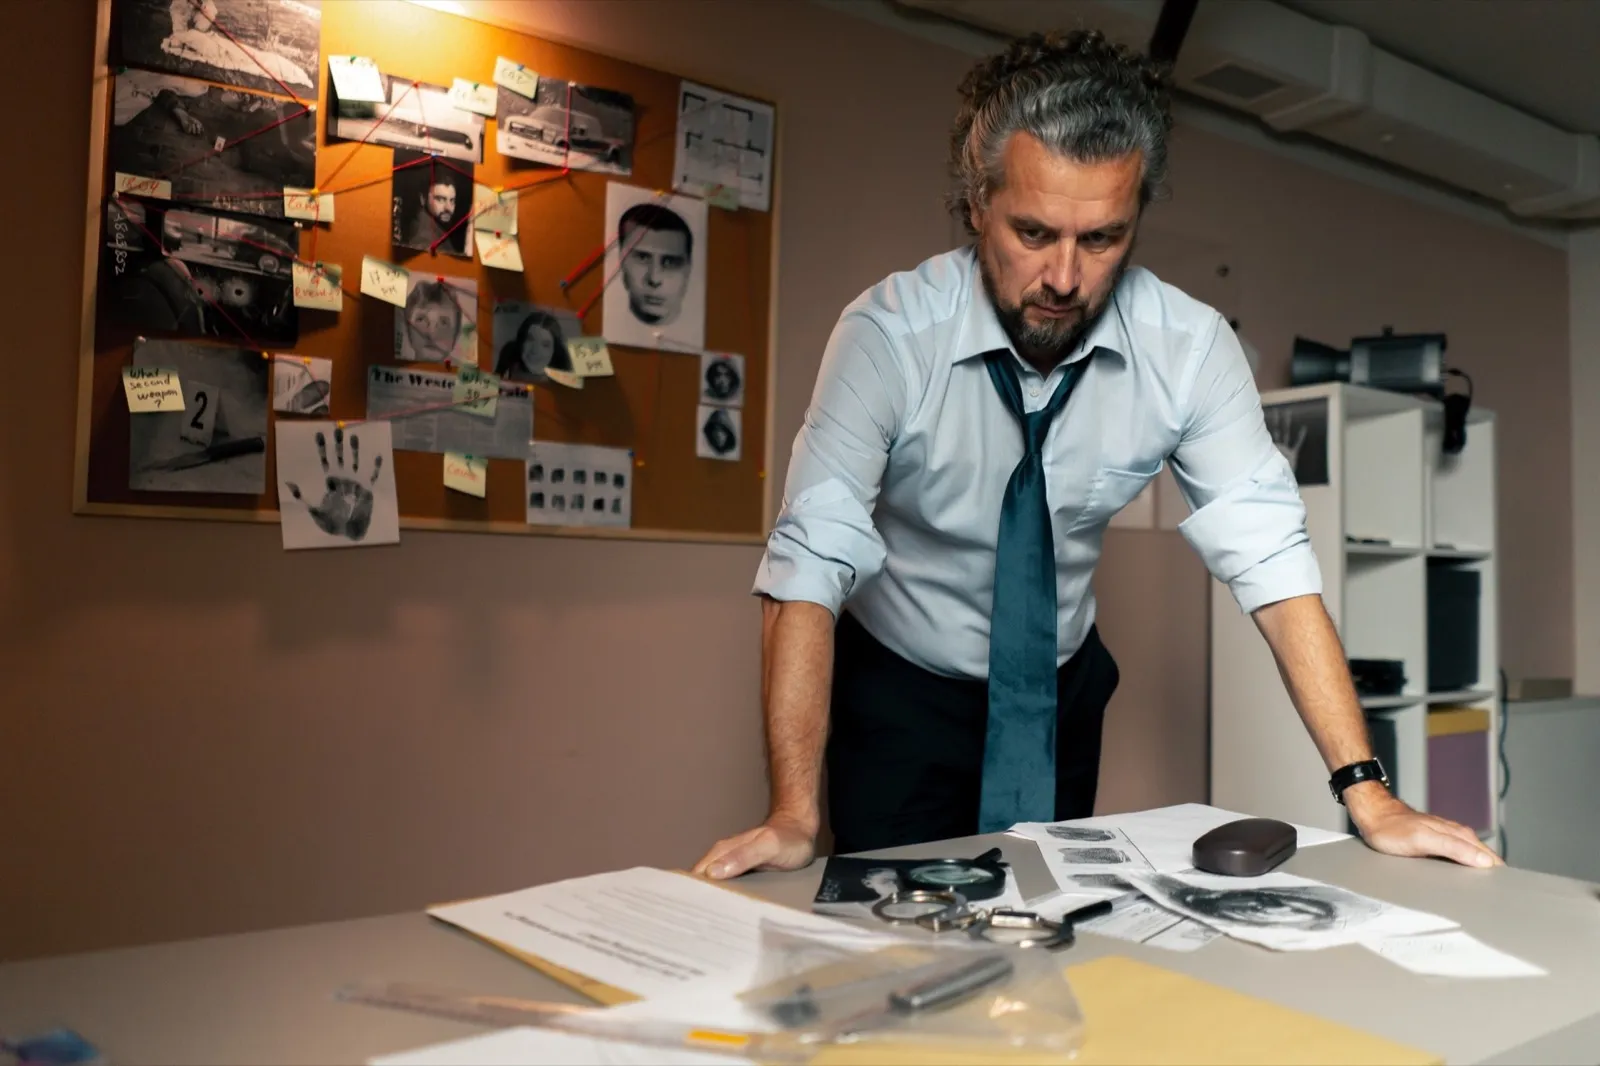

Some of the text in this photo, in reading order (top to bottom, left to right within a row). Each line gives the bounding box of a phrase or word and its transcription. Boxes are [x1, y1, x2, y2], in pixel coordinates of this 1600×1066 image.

[130, 367, 159, 379] What
[372, 365, 404, 384] The
[408, 373, 456, 390] Weste
[130, 373, 171, 390] second
[137, 389, 178, 401] weapon
[154, 399, 162, 409] ?
[190, 391, 208, 430] 2
